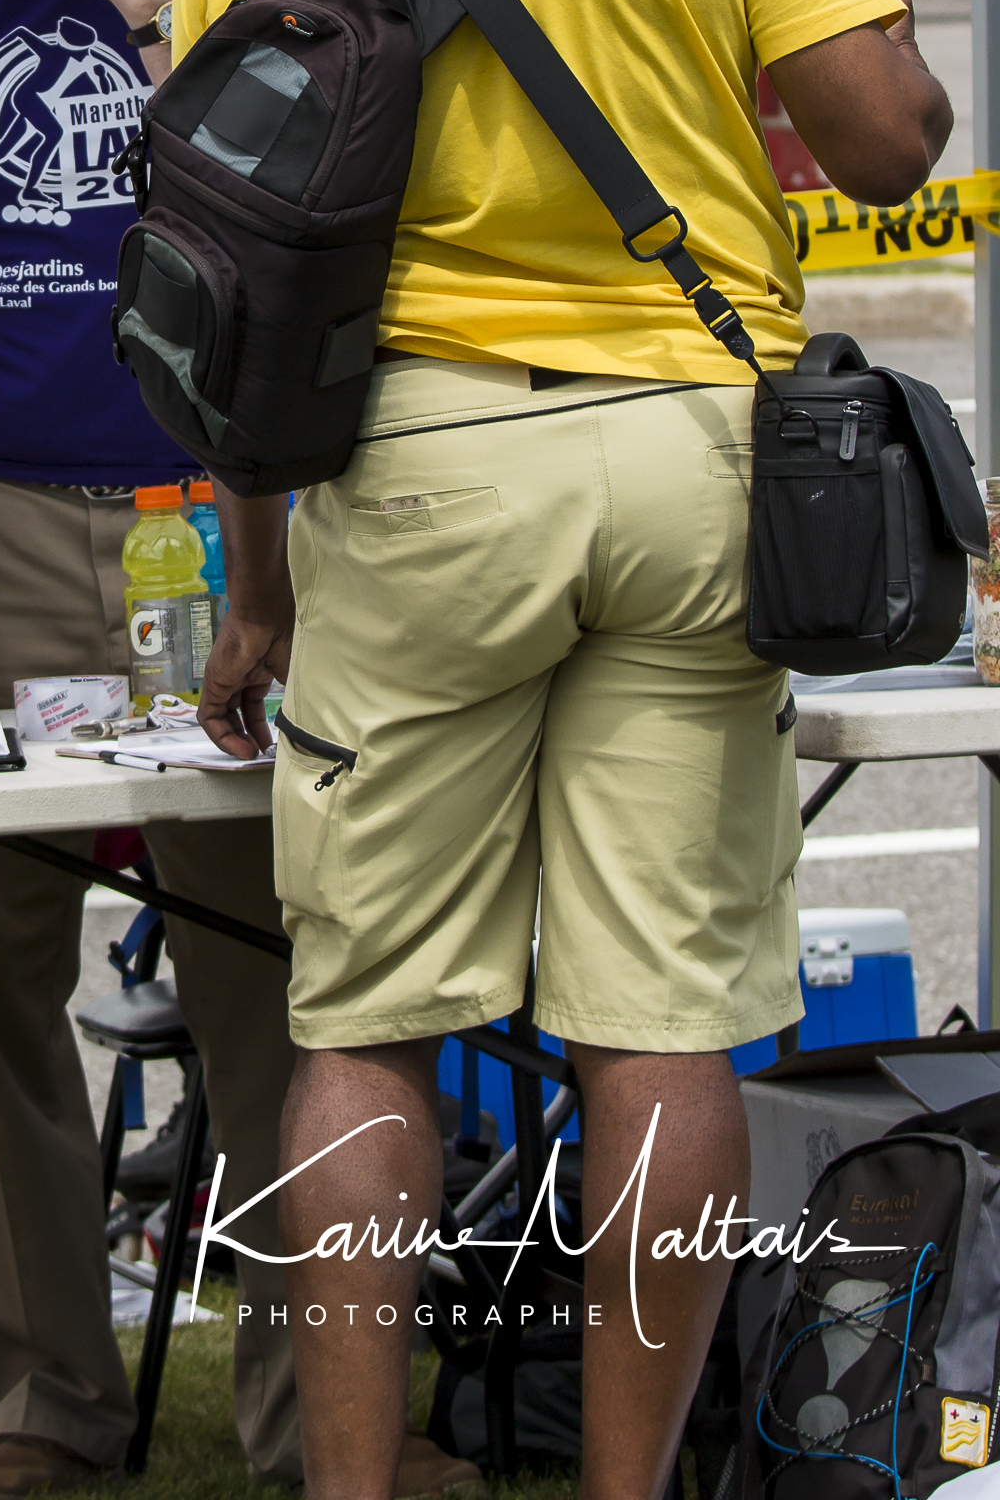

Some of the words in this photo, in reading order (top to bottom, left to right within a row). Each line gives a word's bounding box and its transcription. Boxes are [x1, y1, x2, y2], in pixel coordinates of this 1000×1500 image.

[23, 279, 46, 294] des
[48, 277, 96, 294] Grands
[98, 278, 118, 291] bo
[0, 295, 32, 309] Laval
